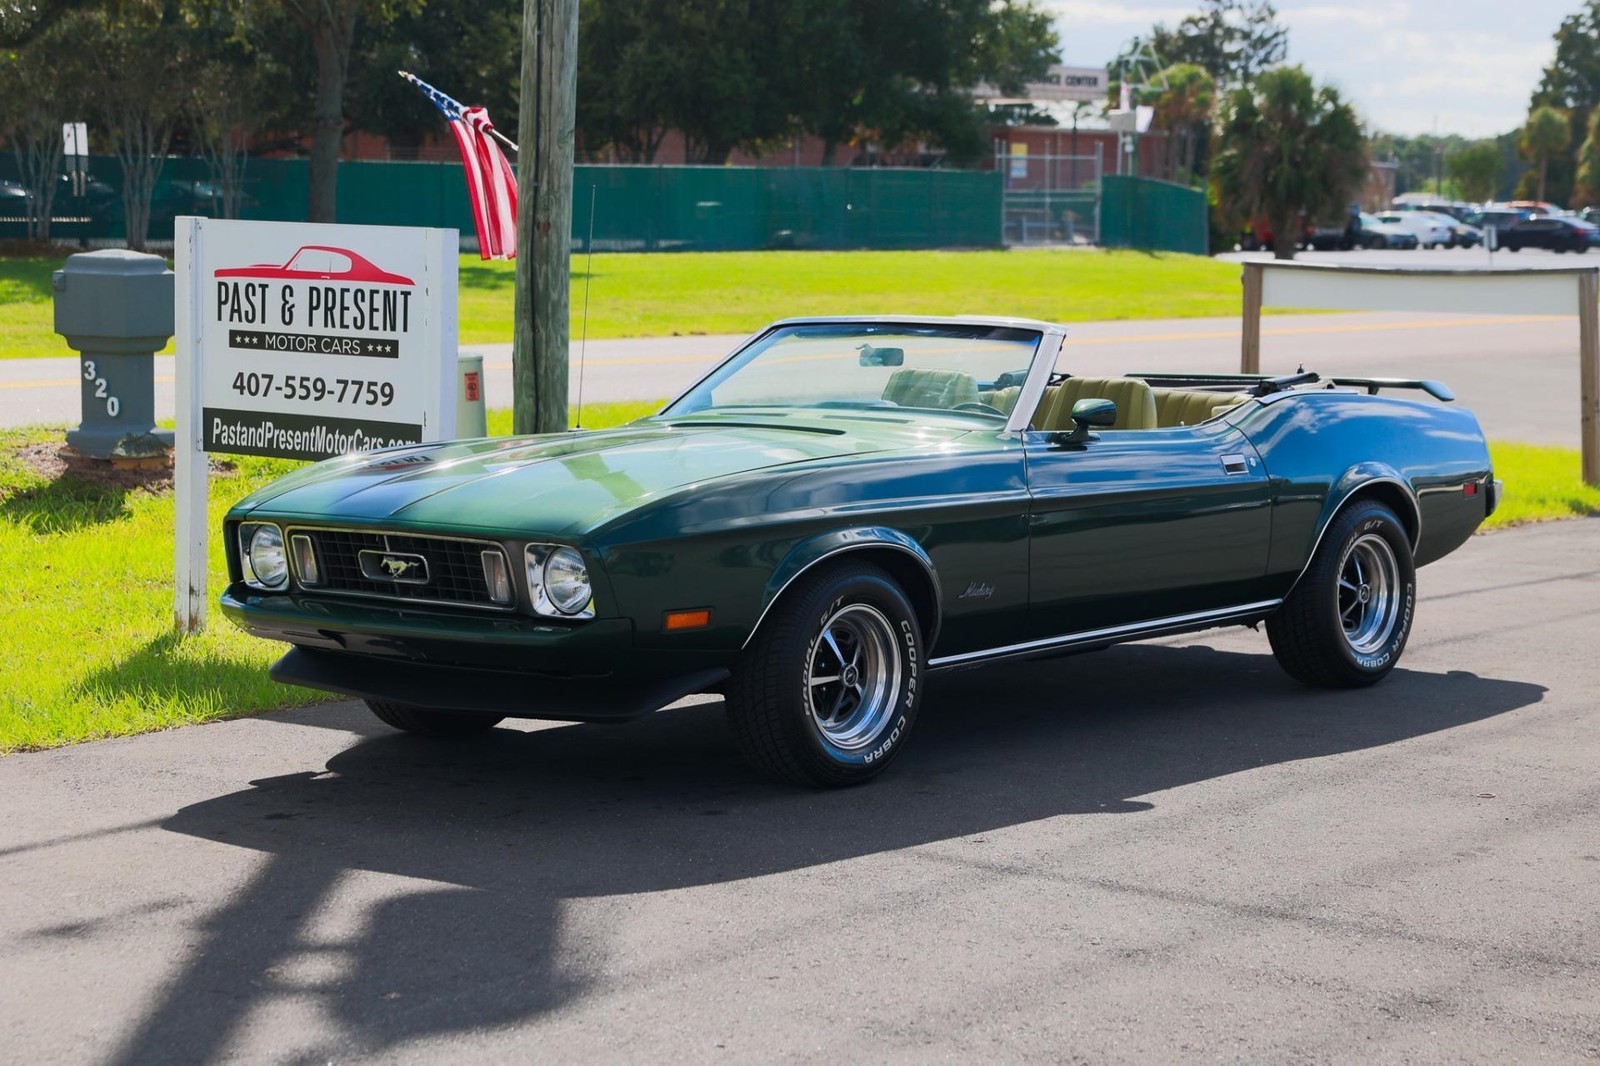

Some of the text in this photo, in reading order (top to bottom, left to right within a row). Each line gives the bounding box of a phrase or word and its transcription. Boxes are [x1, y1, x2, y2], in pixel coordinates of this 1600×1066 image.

[217, 281, 412, 333] PAST & PRESENT
[265, 334, 361, 355] MOTOR CARS
[84, 360, 119, 417] 320
[232, 371, 395, 407] 407-559-7759
[212, 416, 417, 455] PastandPresentMotorCars
[1356, 583, 1413, 668] COOPER COBRA
[864, 620, 917, 763] COOPER COBRA
